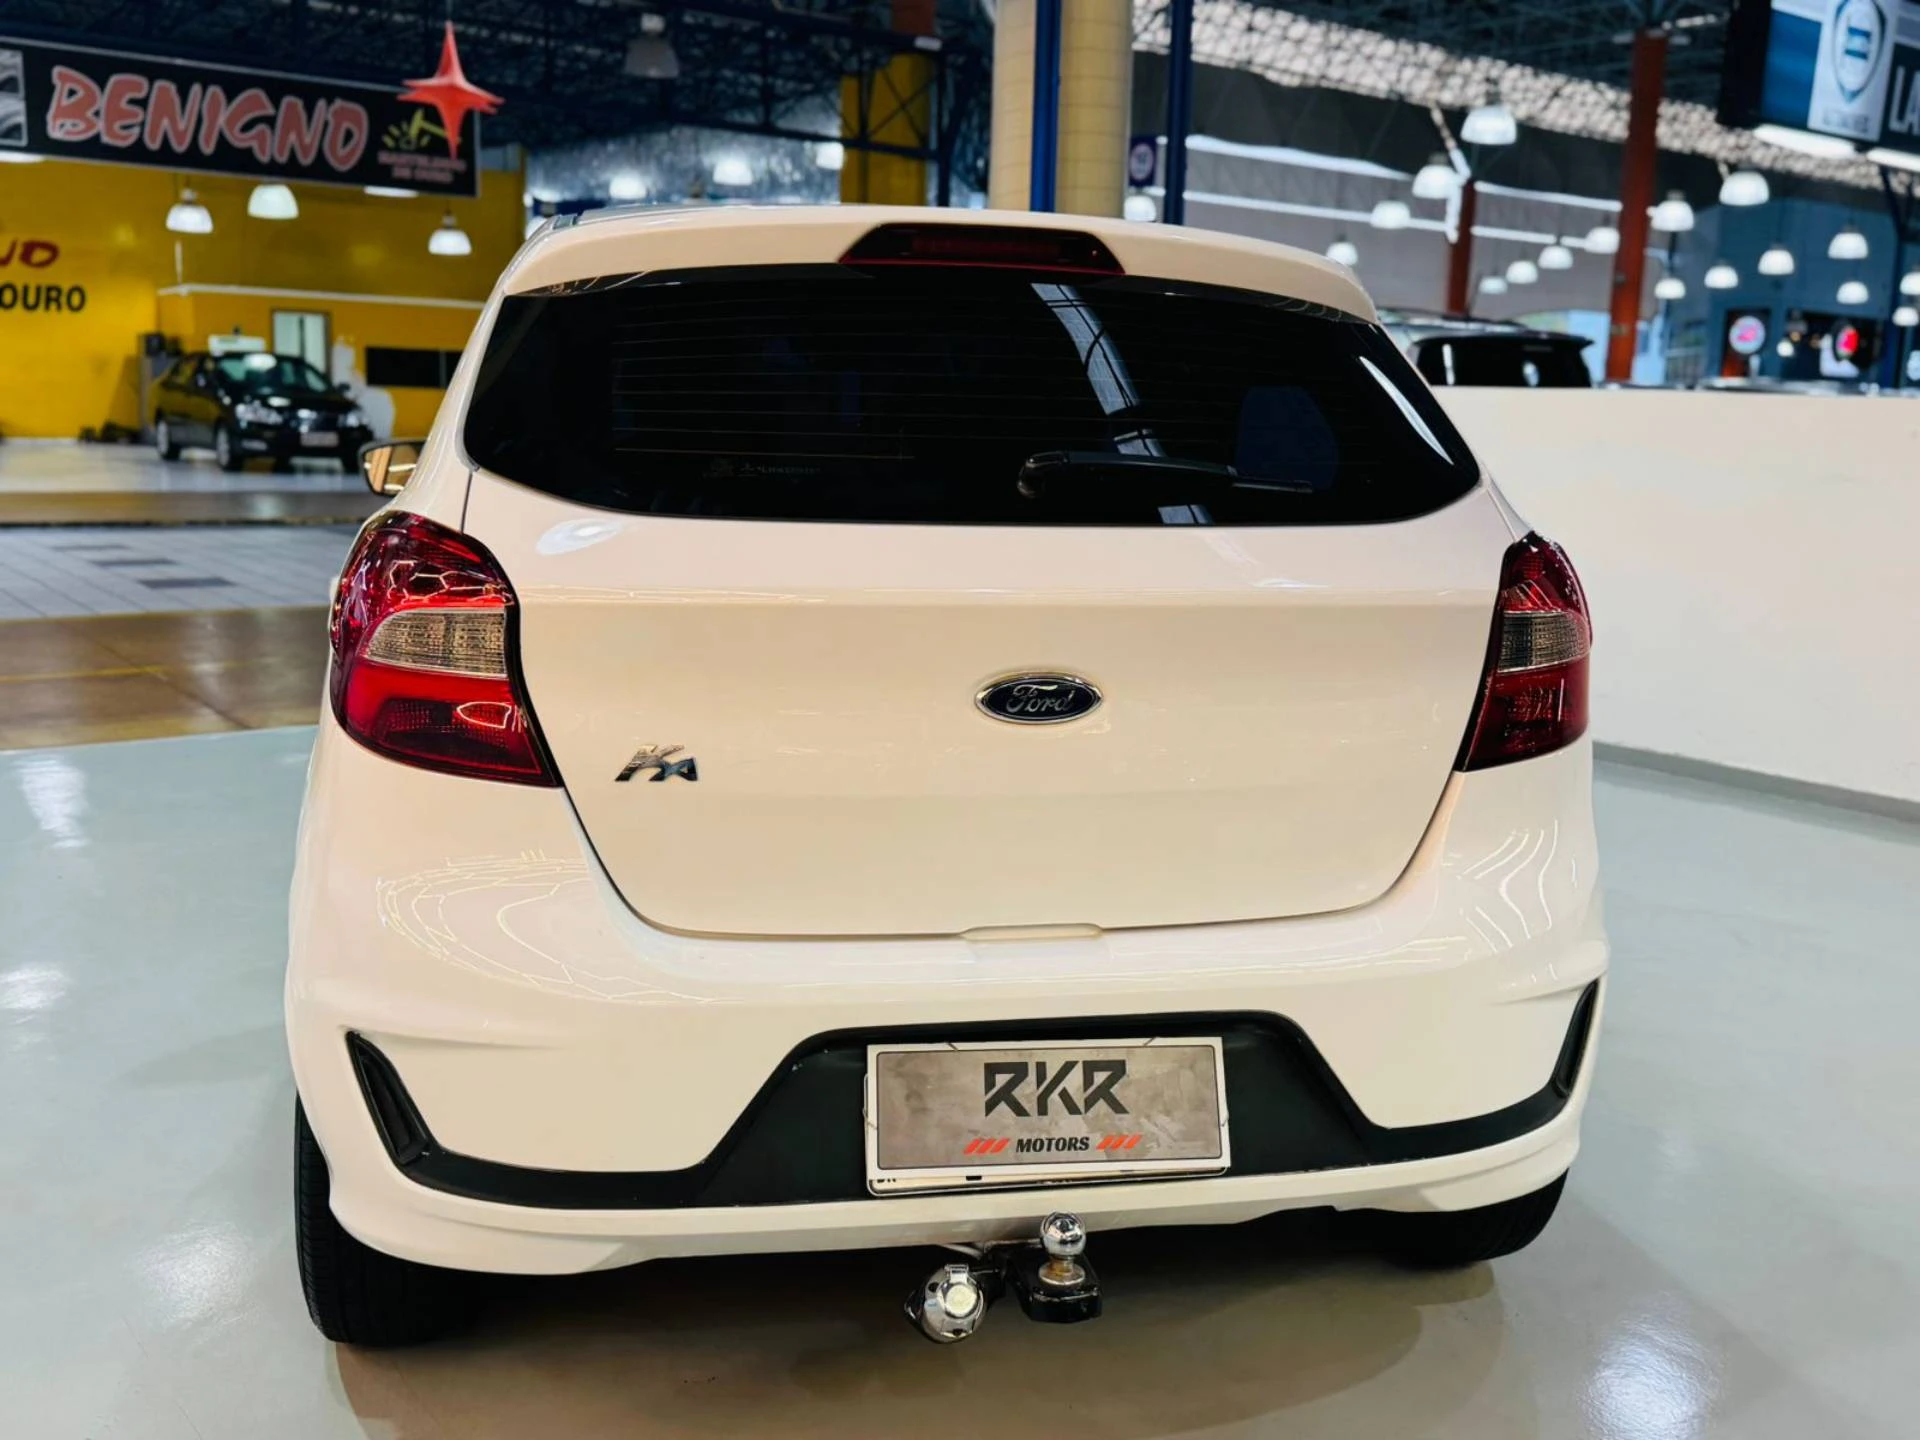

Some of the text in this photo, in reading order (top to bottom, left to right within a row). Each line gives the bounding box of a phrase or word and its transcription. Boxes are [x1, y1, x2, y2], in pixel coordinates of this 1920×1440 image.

[47, 65, 369, 172] BENIGNO
[0, 281, 87, 313] OURO
[1005, 684, 1076, 713] Ford
[983, 1058, 1130, 1118] RKR
[1015, 1136, 1090, 1153] MOTORS
